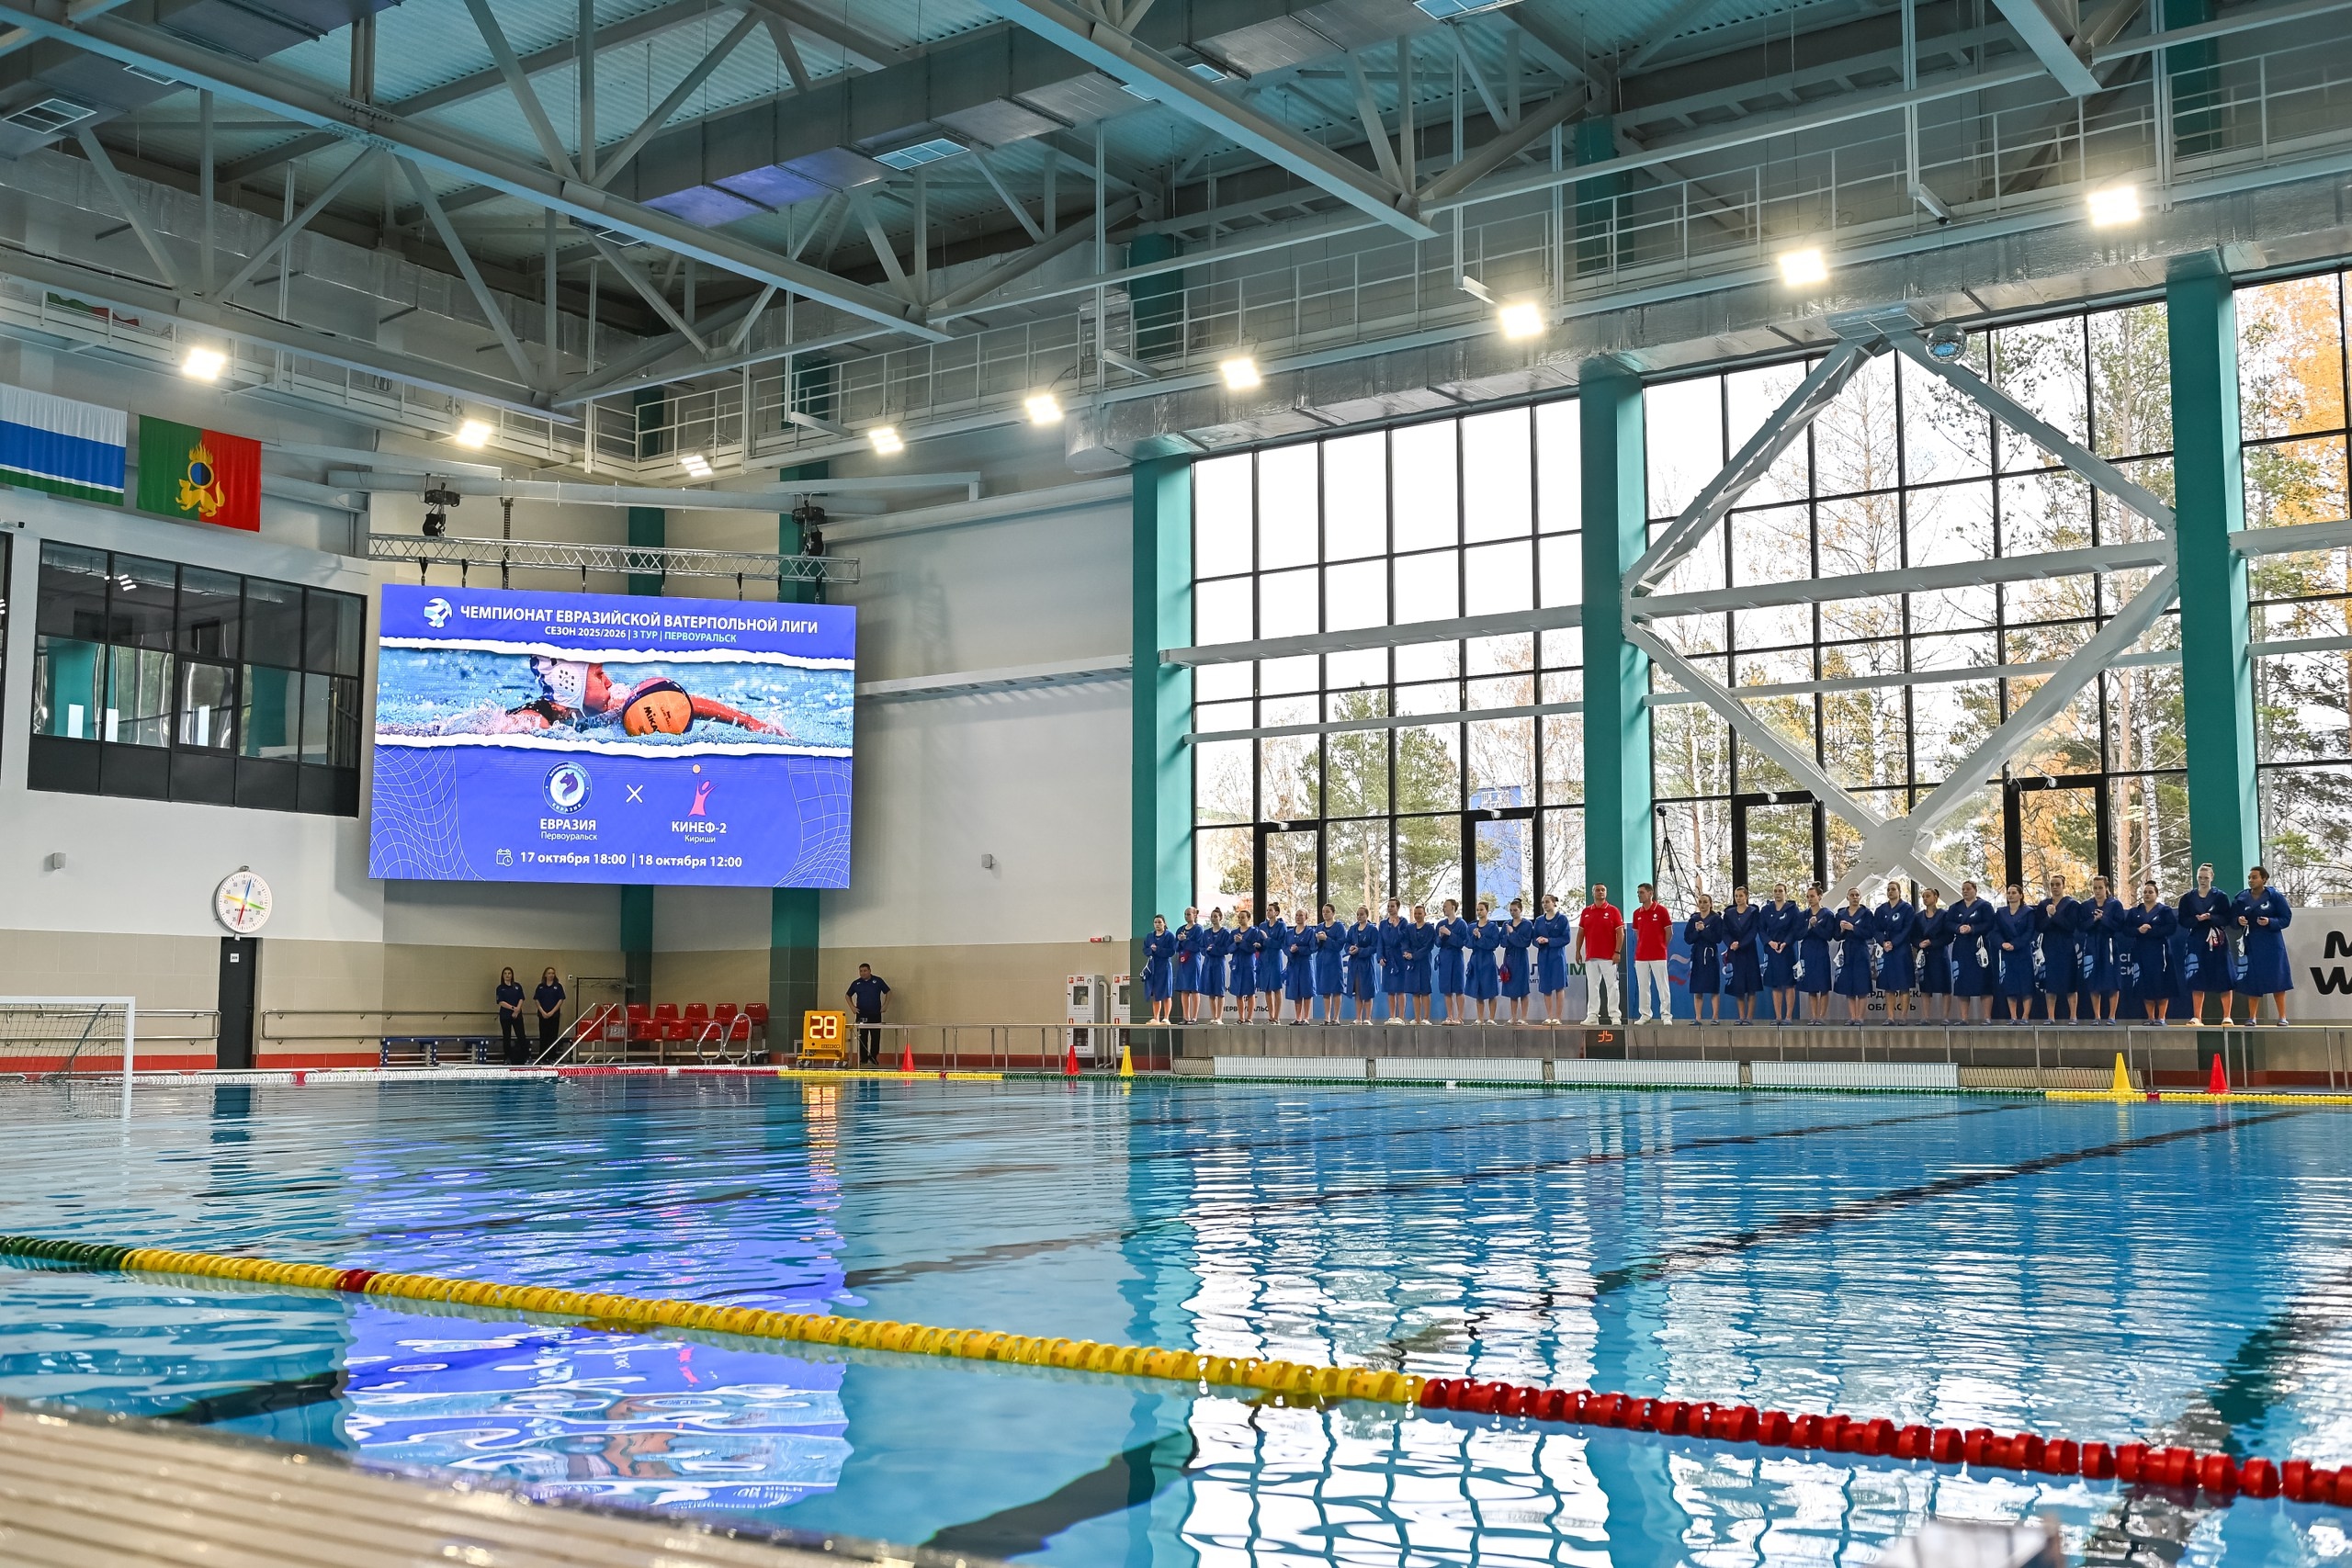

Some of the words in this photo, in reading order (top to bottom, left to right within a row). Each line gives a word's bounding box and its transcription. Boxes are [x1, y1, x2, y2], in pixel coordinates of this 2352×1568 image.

[460, 605, 553, 622] ЧЕМПИОНАТ
[556, 609, 661, 626] ЕВРАЗИЙСКОЙ
[664, 614, 778, 632] ВАТЕРПОЛЬНОЙ
[780, 620, 819, 634] ЛИГИ
[545, 626, 576, 636] СЕЗОН
[578, 627, 626, 638] 2025/2026
[632, 629, 639, 638] 3
[640, 630, 658, 639] ТУР
[664, 631, 737, 643] ПЕРВОУРАЛЬСК
[540, 818, 596, 831] ЕВРАЗИЯ
[671, 820, 727, 834] КИНЕФ-2
[540, 830, 598, 842] Первоуральск
[684, 834, 716, 844] Кириши
[520, 852, 536, 863] 17
[537, 852, 590, 866] октября
[594, 852, 627, 865] 18:00
[639, 854, 653, 866] 18
[655, 854, 707, 869] октября
[710, 855, 742, 868] 12:00
[809, 1015, 837, 1039] 28
